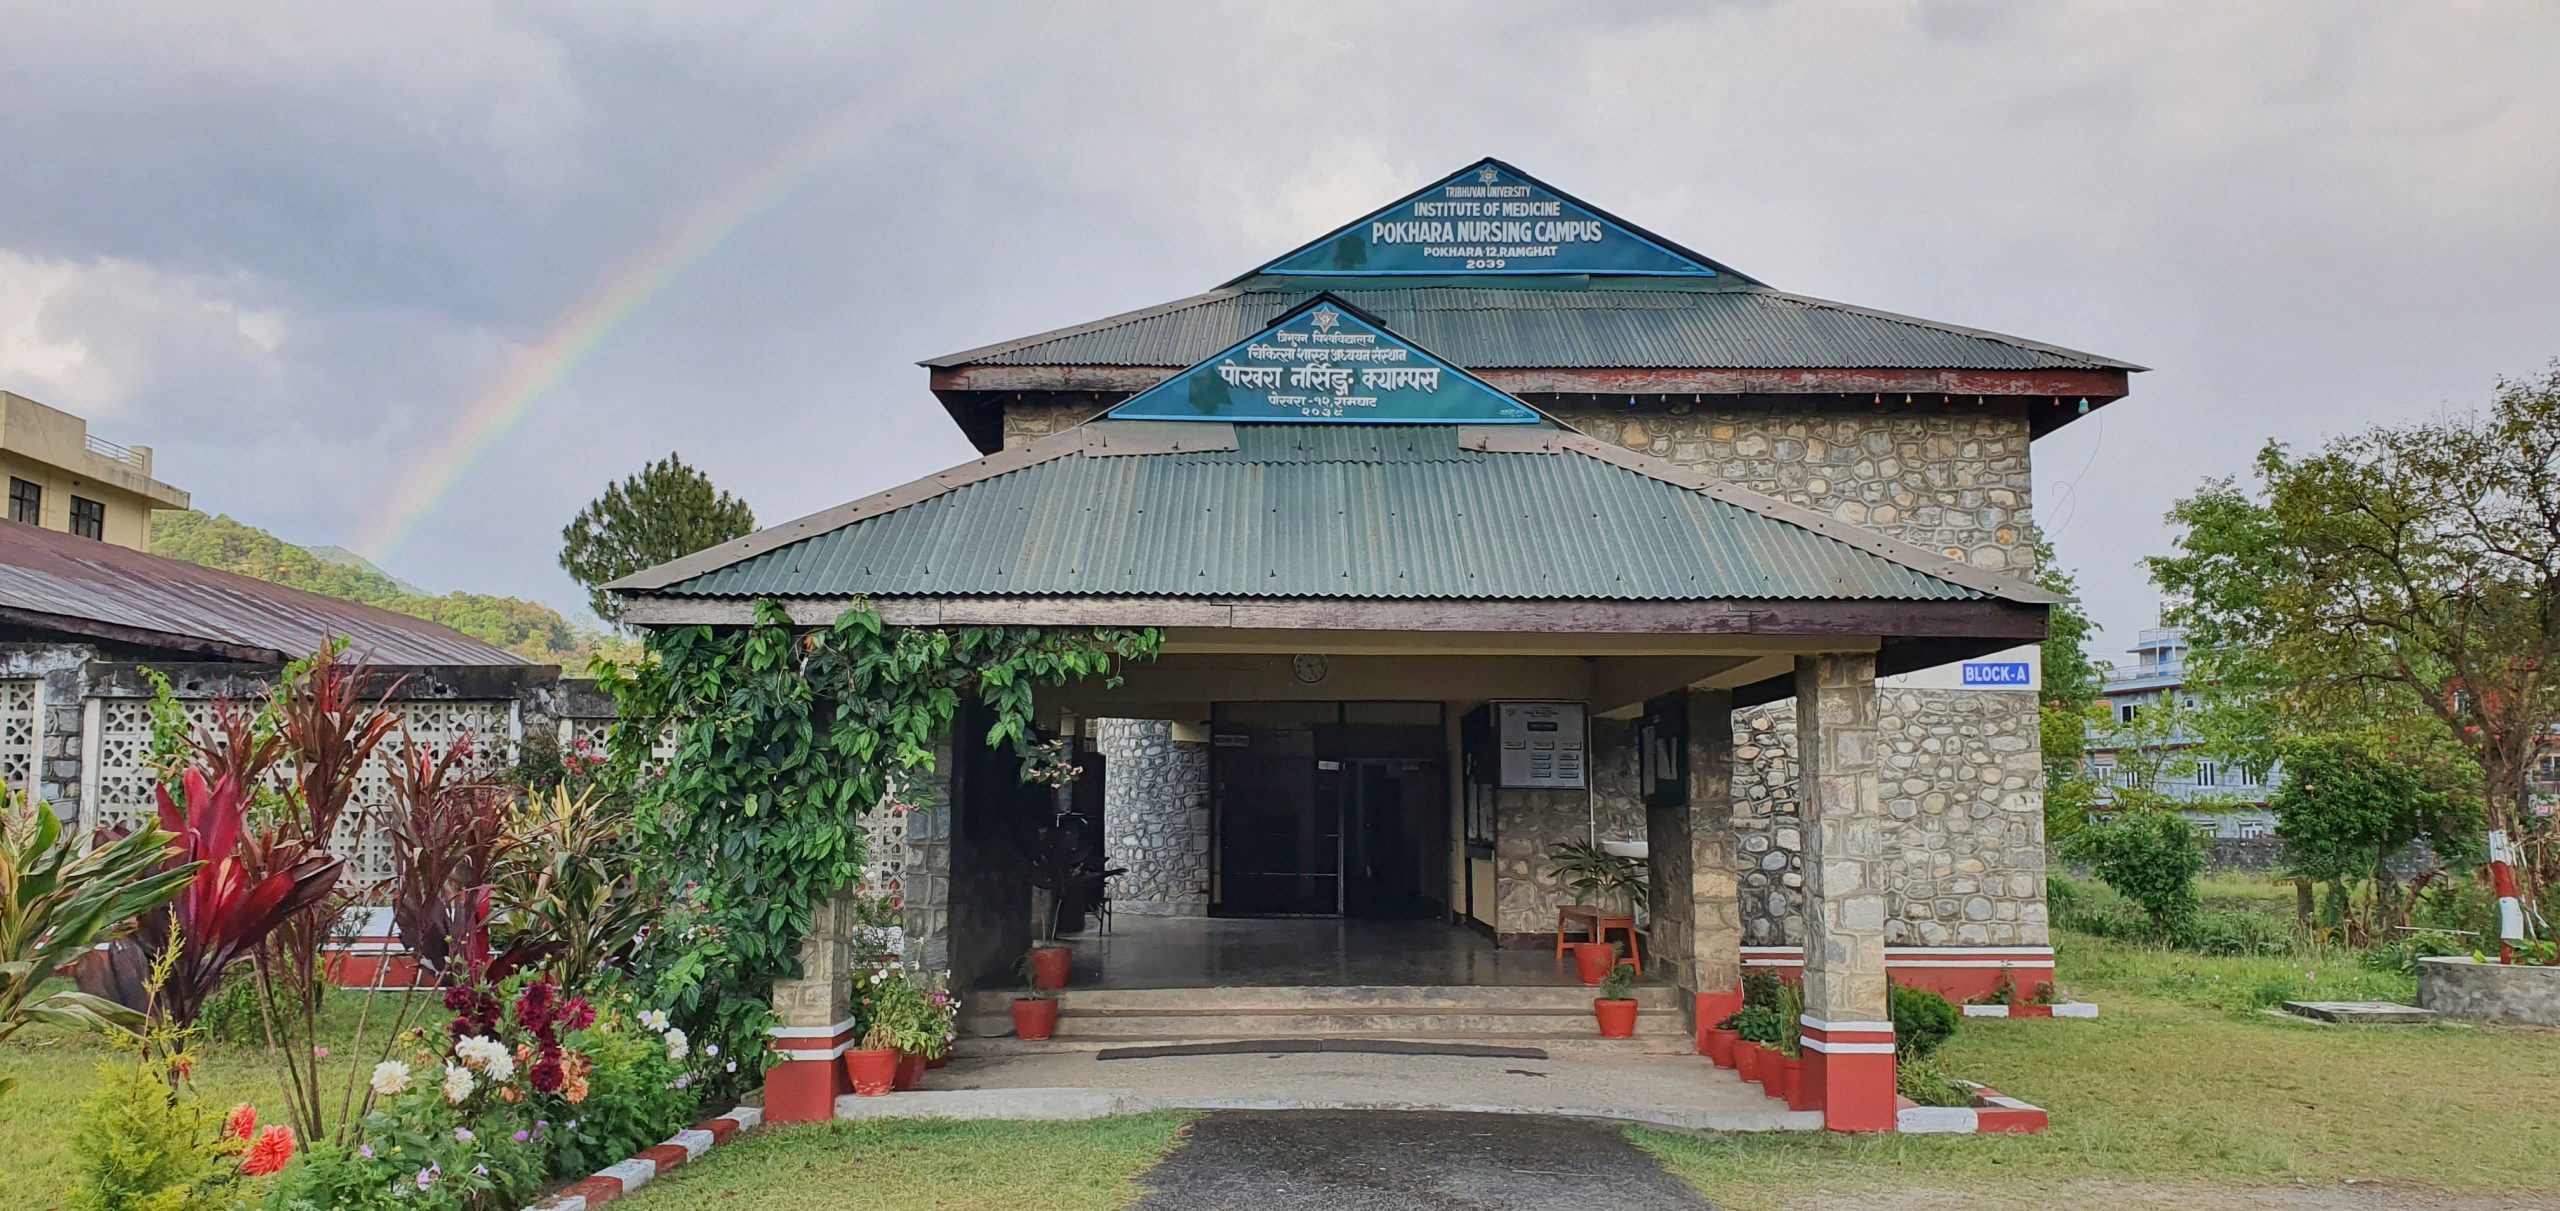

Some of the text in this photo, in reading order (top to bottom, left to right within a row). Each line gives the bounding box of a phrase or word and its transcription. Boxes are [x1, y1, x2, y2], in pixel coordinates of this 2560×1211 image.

[1445, 186, 1531, 198] TRIBHUVAN UNIVERSITY
[1414, 202, 1561, 217] INSTITUTE OF MEDICINE
[1372, 221, 1602, 244] POKHARA NURSING CAMPUS
[1466, 260, 1506, 269] 2039
[1276, 330, 1376, 347] त्रिभुवन विश्वविद्यालय
[1247, 344, 1408, 364] चिकित्सा शास्त्र अध्ययन संस्थान
[1218, 359, 1284, 389] पोखरा
[1362, 368, 1441, 393] क्याम्पस
[1965, 666, 2027, 682] BLOCK-A
